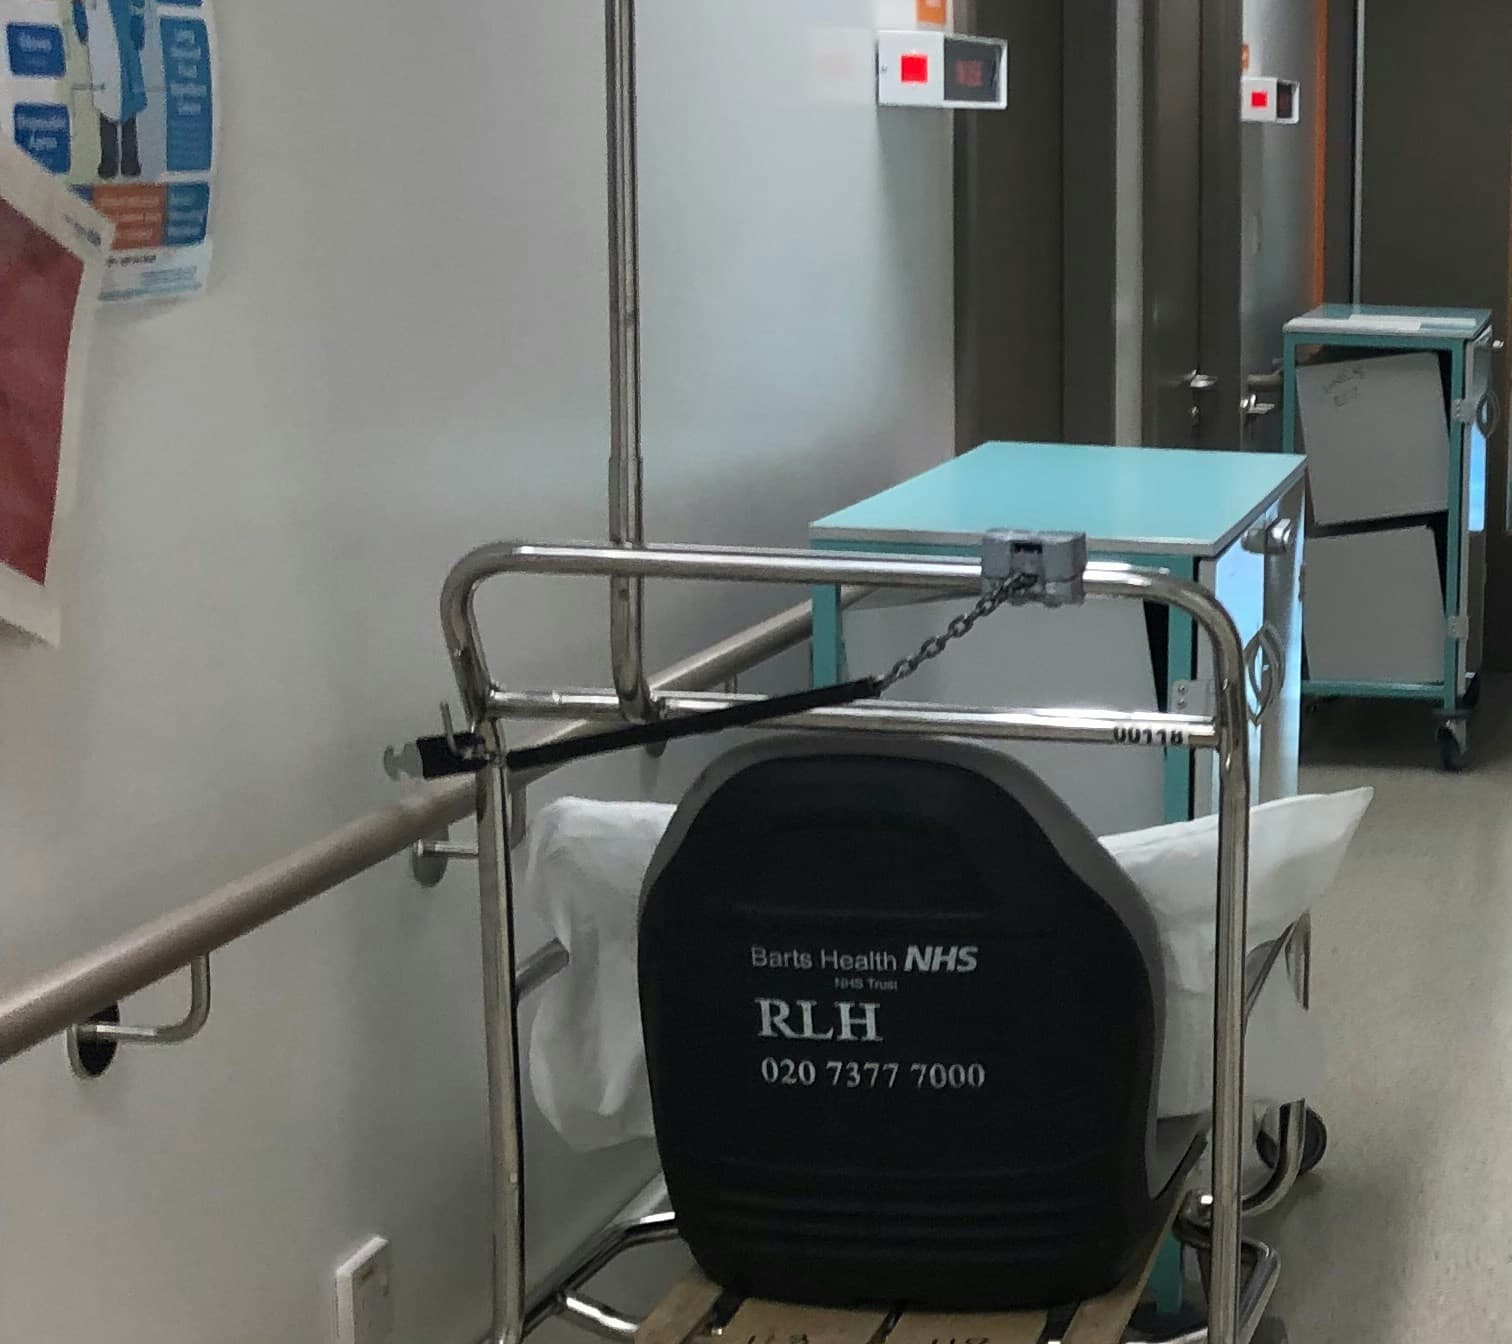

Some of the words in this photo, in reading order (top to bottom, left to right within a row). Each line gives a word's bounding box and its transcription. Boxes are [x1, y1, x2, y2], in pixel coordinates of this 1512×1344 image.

[1113, 726, 1184, 745] 00118
[751, 946, 813, 969] Barts
[820, 949, 897, 972] Health
[904, 945, 979, 973] NHS
[834, 977, 864, 989] NHS
[869, 977, 898, 991] Trust
[754, 997, 883, 1042] RLH
[761, 1057, 817, 1086] 020
[825, 1061, 899, 1088] 7377
[910, 1062, 986, 1089] 7000
